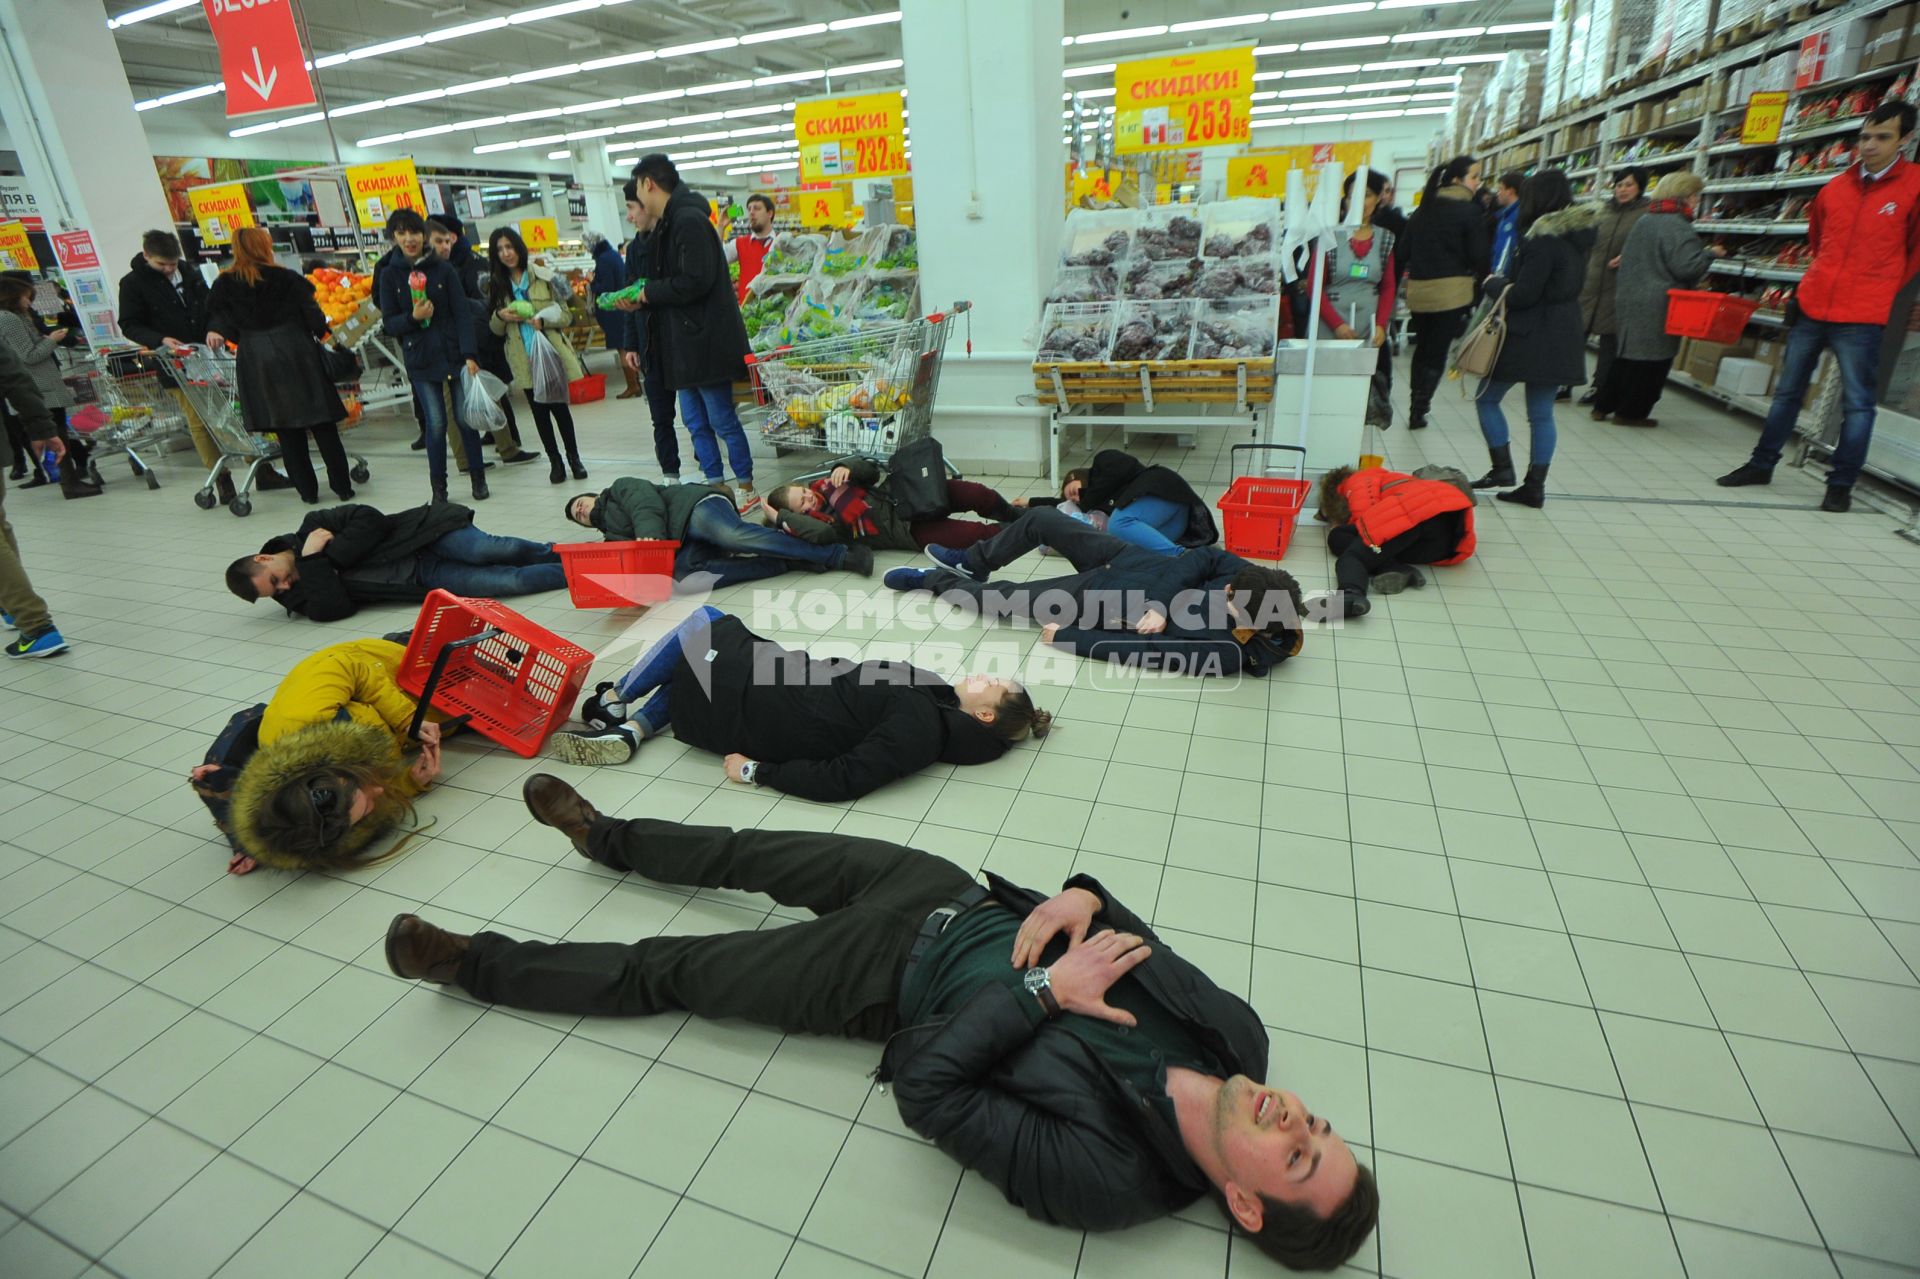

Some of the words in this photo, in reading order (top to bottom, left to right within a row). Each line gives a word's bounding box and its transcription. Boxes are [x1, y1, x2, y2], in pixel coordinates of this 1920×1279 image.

[1131, 69, 1239, 100] СКИДКИ!
[805, 112, 889, 136] СКИДКИ!
[1187, 98, 1231, 142] 253
[1233, 117, 1248, 138] 95
[857, 136, 888, 173] 232
[890, 152, 904, 170] 95
[356, 174, 410, 192] СКИДКИ!
[198, 197, 242, 214] СКИДКИ!
